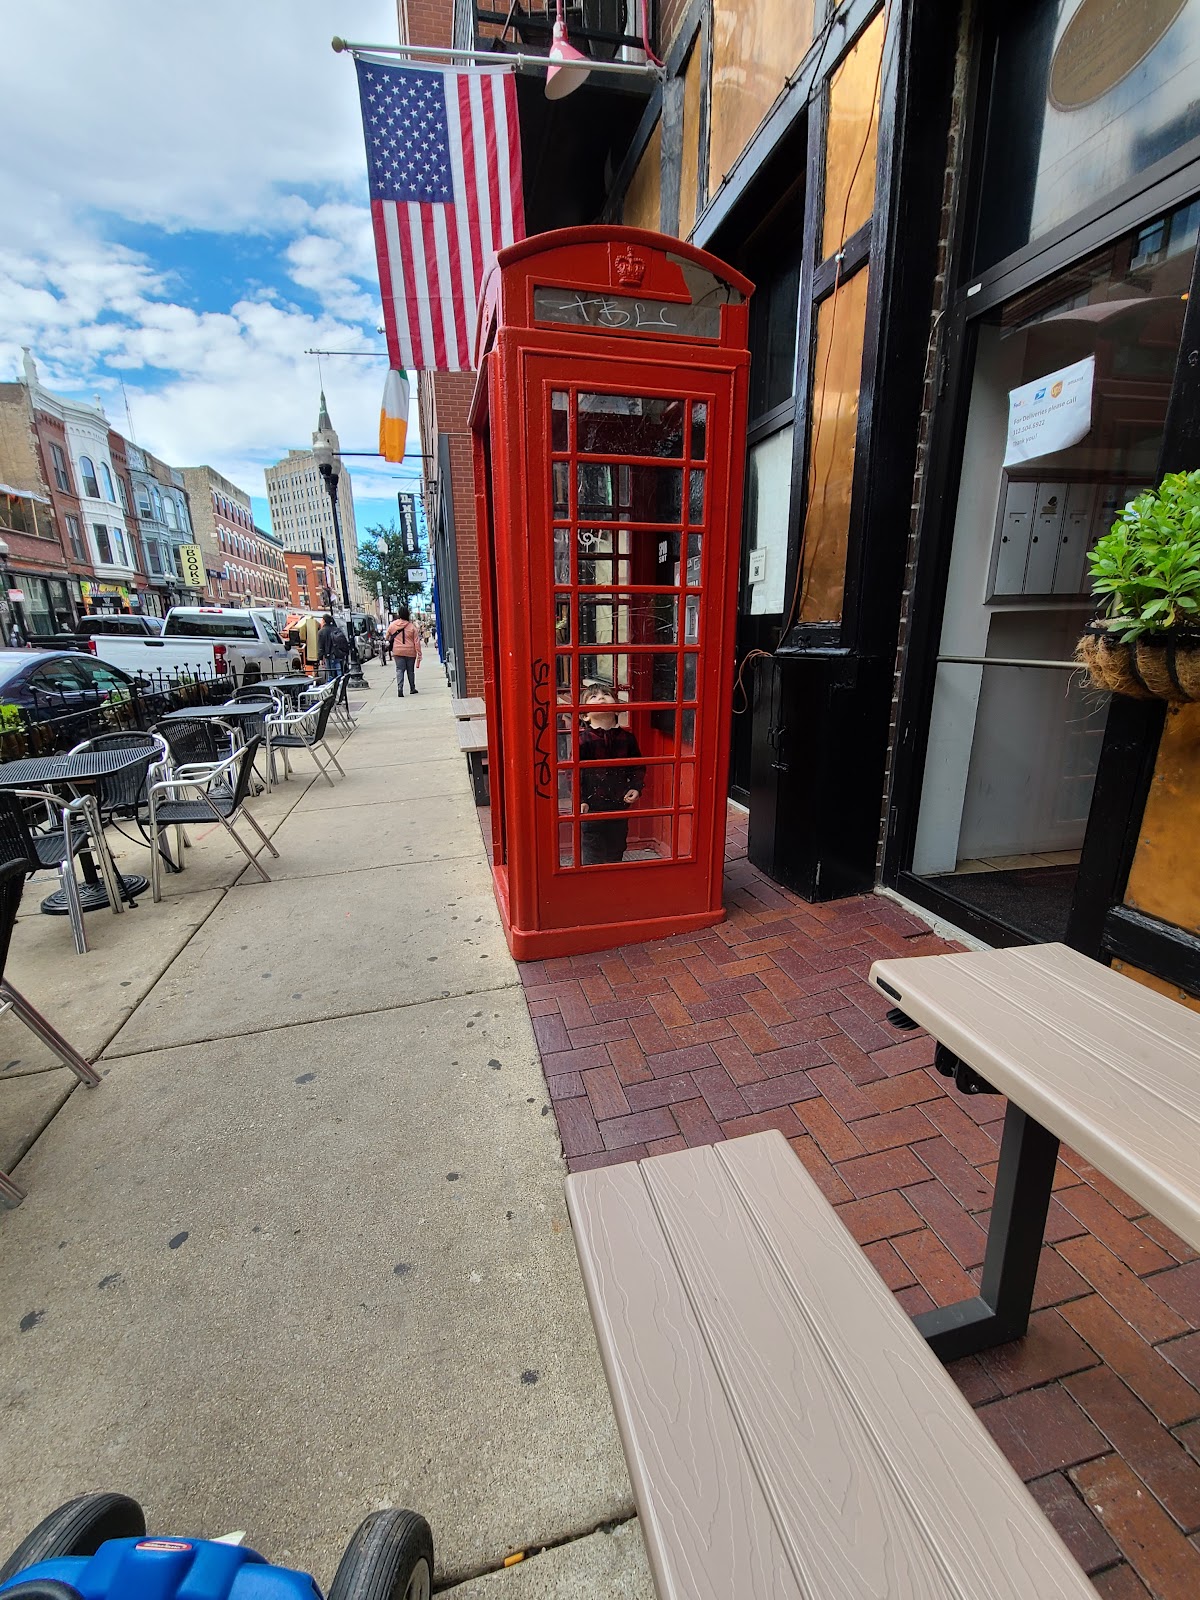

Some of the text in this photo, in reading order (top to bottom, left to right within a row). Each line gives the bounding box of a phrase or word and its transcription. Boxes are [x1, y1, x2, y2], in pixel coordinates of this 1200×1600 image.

[1013, 417, 1022, 425] For
[1022, 408, 1047, 422] Deliveries
[1047, 401, 1066, 414] please
[1066, 396, 1077, 405] call
[1012, 437, 1025, 447] Thank
[186, 549, 200, 585] BOOKS
